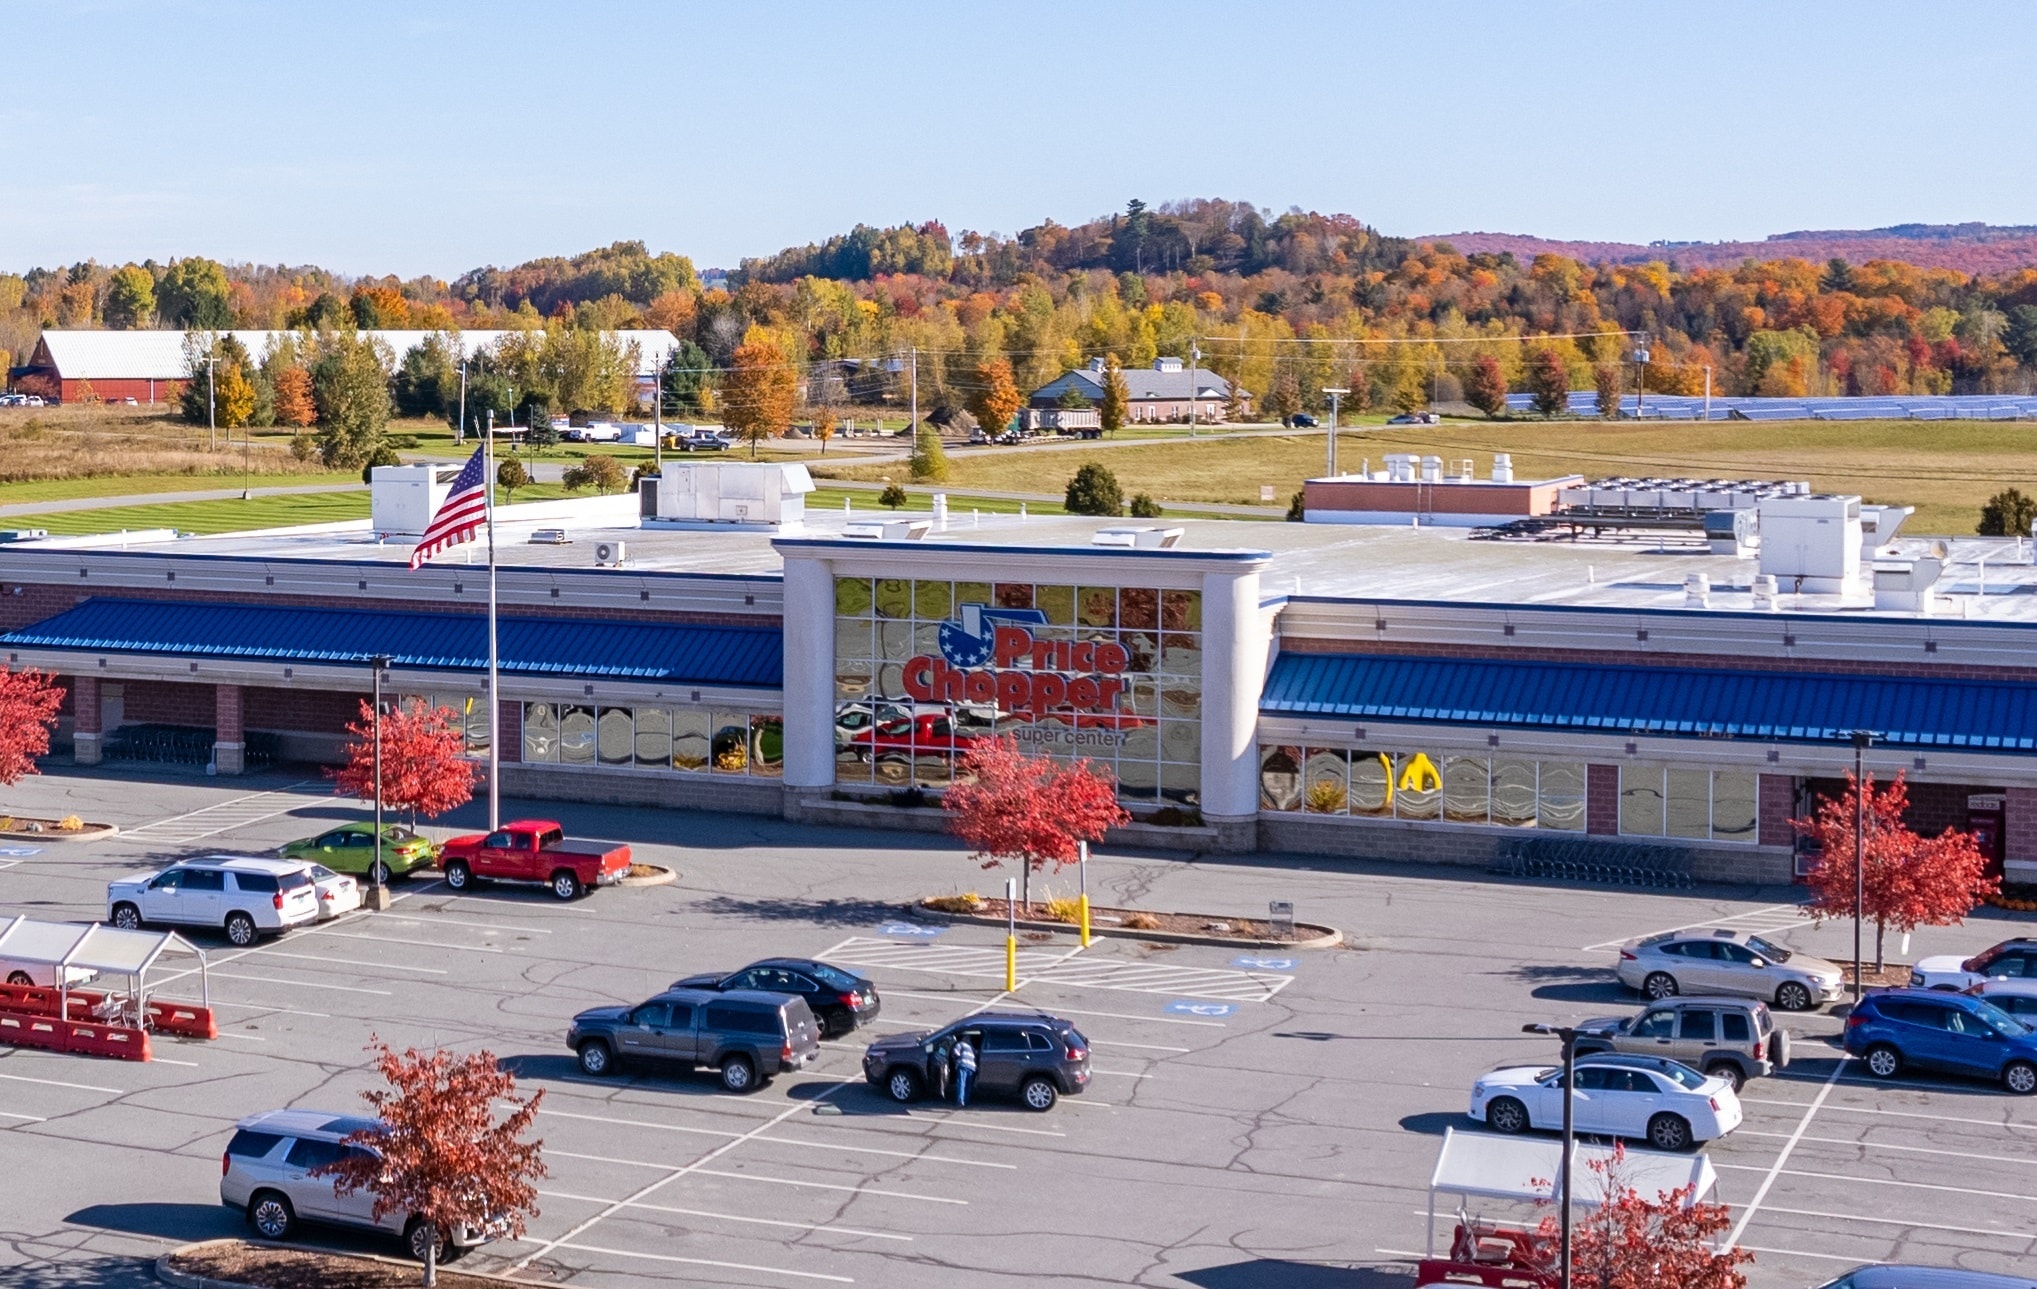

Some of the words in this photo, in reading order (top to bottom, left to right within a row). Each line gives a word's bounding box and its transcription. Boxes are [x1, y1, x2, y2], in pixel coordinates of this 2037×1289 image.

[995, 626, 1129, 674] Price
[902, 655, 1126, 714] Chopper
[1013, 728, 1061, 744] super
[1064, 730, 1122, 746] center
